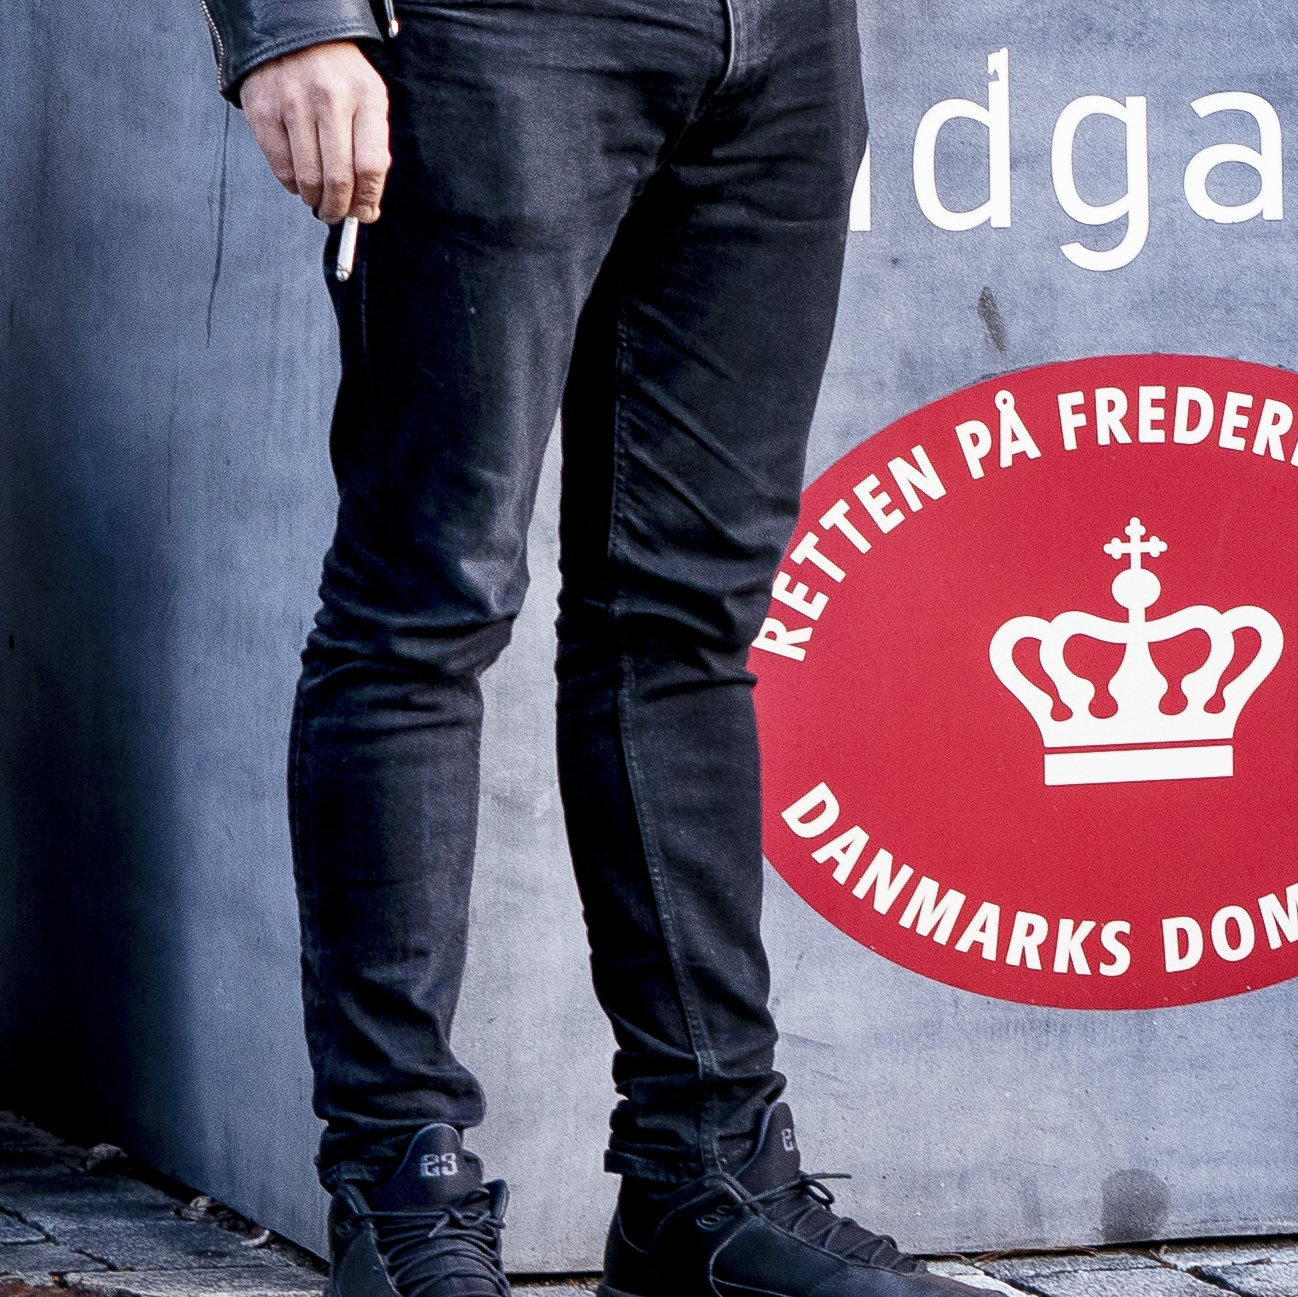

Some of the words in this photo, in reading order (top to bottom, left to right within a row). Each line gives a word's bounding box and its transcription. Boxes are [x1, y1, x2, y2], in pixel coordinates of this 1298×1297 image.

[751, 443, 948, 662] RETTEN
[953, 388, 1042, 481] PÅ
[779, 780, 1132, 978] DANMARKS
[420, 1152, 458, 1177] 23
